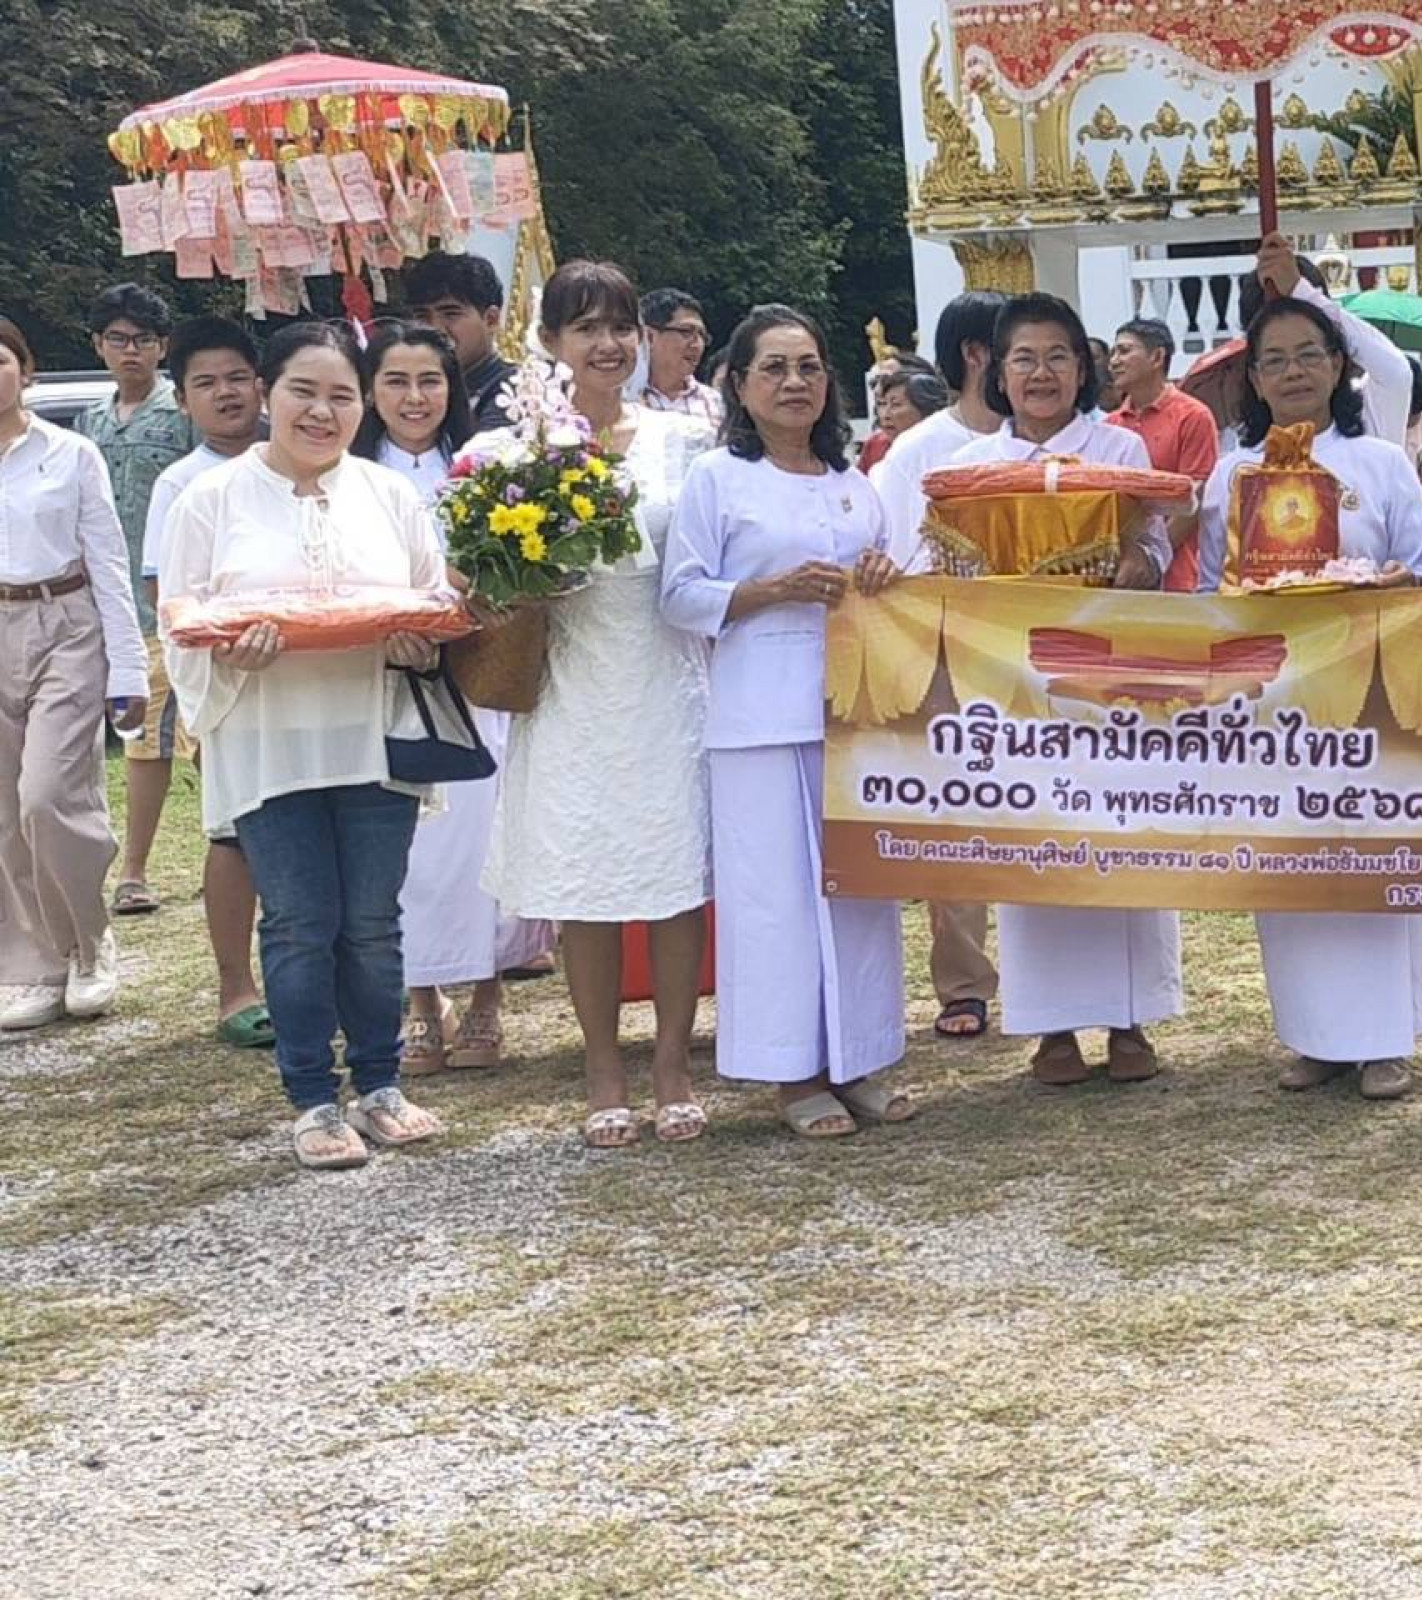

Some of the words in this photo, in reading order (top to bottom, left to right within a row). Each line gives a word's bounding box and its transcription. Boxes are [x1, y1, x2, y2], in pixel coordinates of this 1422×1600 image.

[932, 698, 1374, 773] กฐินสามัคคีทั่วไทย
[862, 777, 1037, 813] ๓๐,๐๐๐
[1051, 777, 1091, 811] วัด
[1103, 781, 1281, 826] พุทธศักราช
[877, 832, 917, 857] โดย
[922, 838, 1088, 872] คณะศิษยานุศิษย์
[1094, 848, 1193, 874] บูชาธรรม
[1198, 852, 1230, 870] ๘๑
[1235, 846, 1252, 871] ปี
